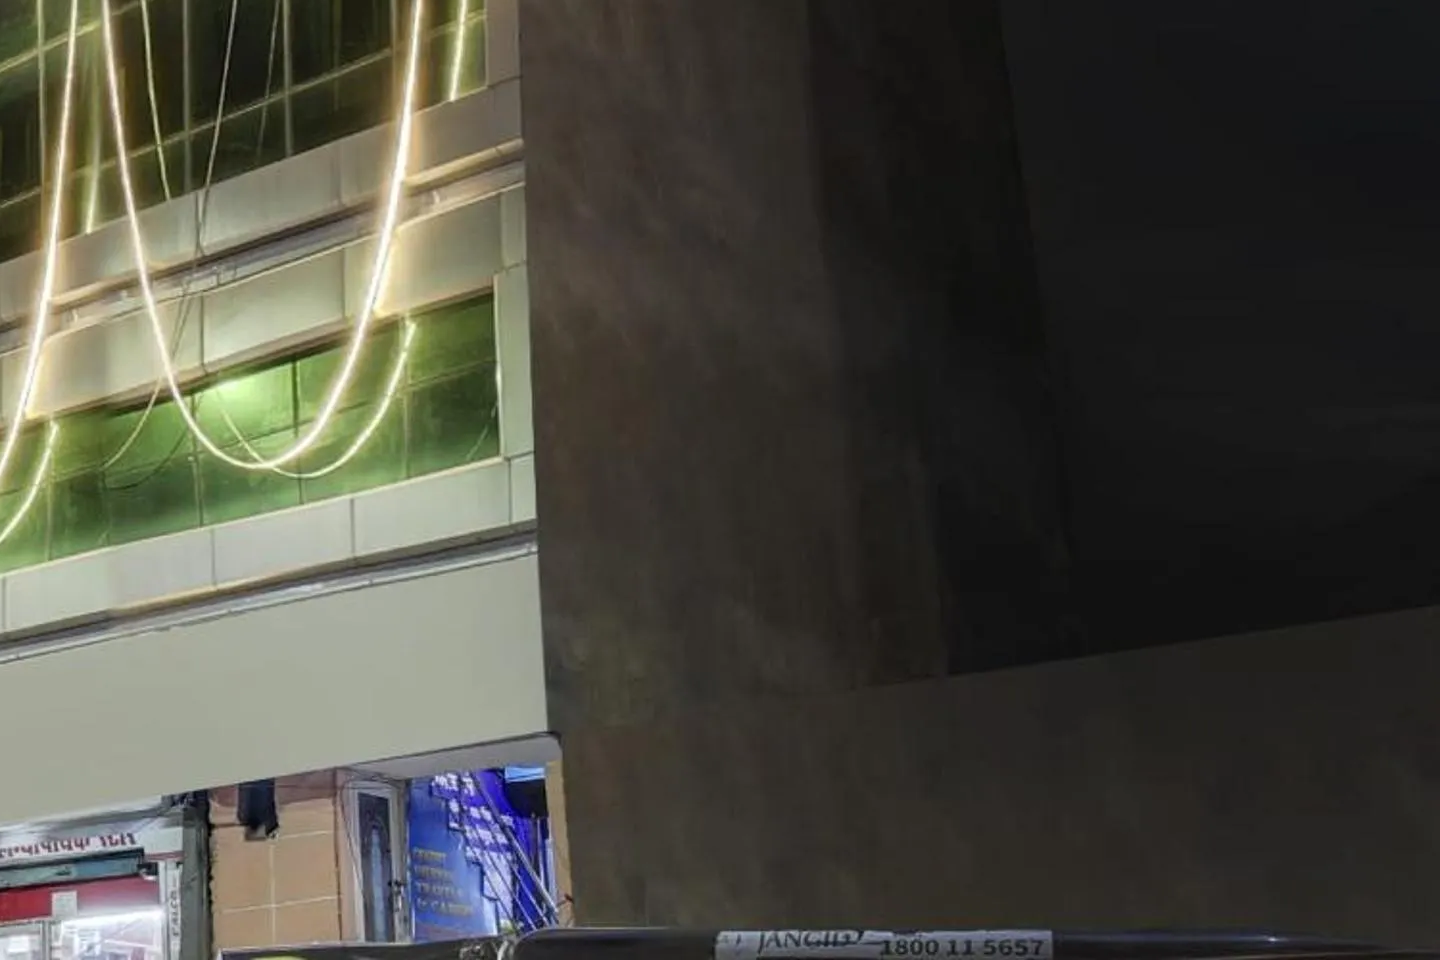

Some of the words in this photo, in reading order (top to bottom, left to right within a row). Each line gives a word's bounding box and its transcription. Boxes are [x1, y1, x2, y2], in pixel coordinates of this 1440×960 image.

[881, 938, 939, 956] 1800
[946, 939, 974, 956] 11
[983, 939, 1045, 957] 5657
